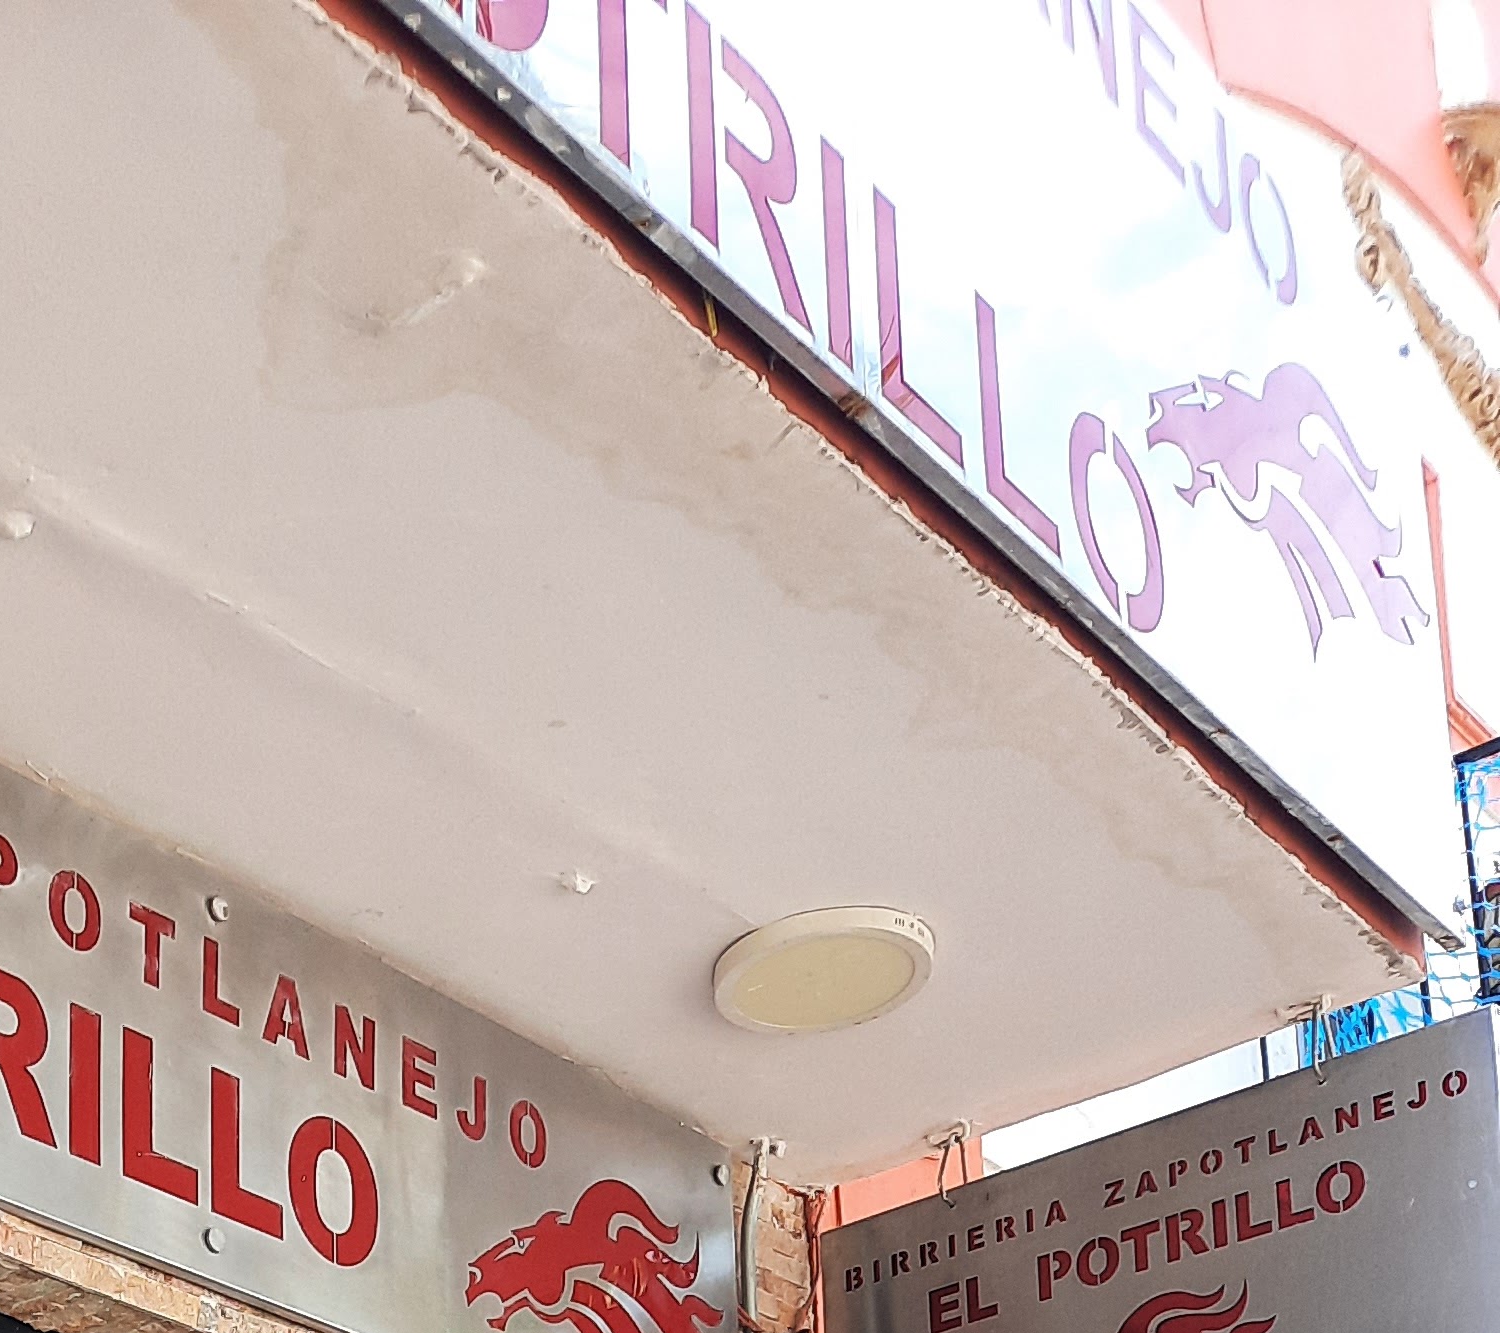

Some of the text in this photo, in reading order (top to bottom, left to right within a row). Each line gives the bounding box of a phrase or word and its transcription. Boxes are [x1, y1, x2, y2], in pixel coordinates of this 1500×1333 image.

[845, 1070, 1469, 1293] BIRRIERIA ZAPOTLANEJO
[1037, 1160, 1366, 1301] POTRILLO
